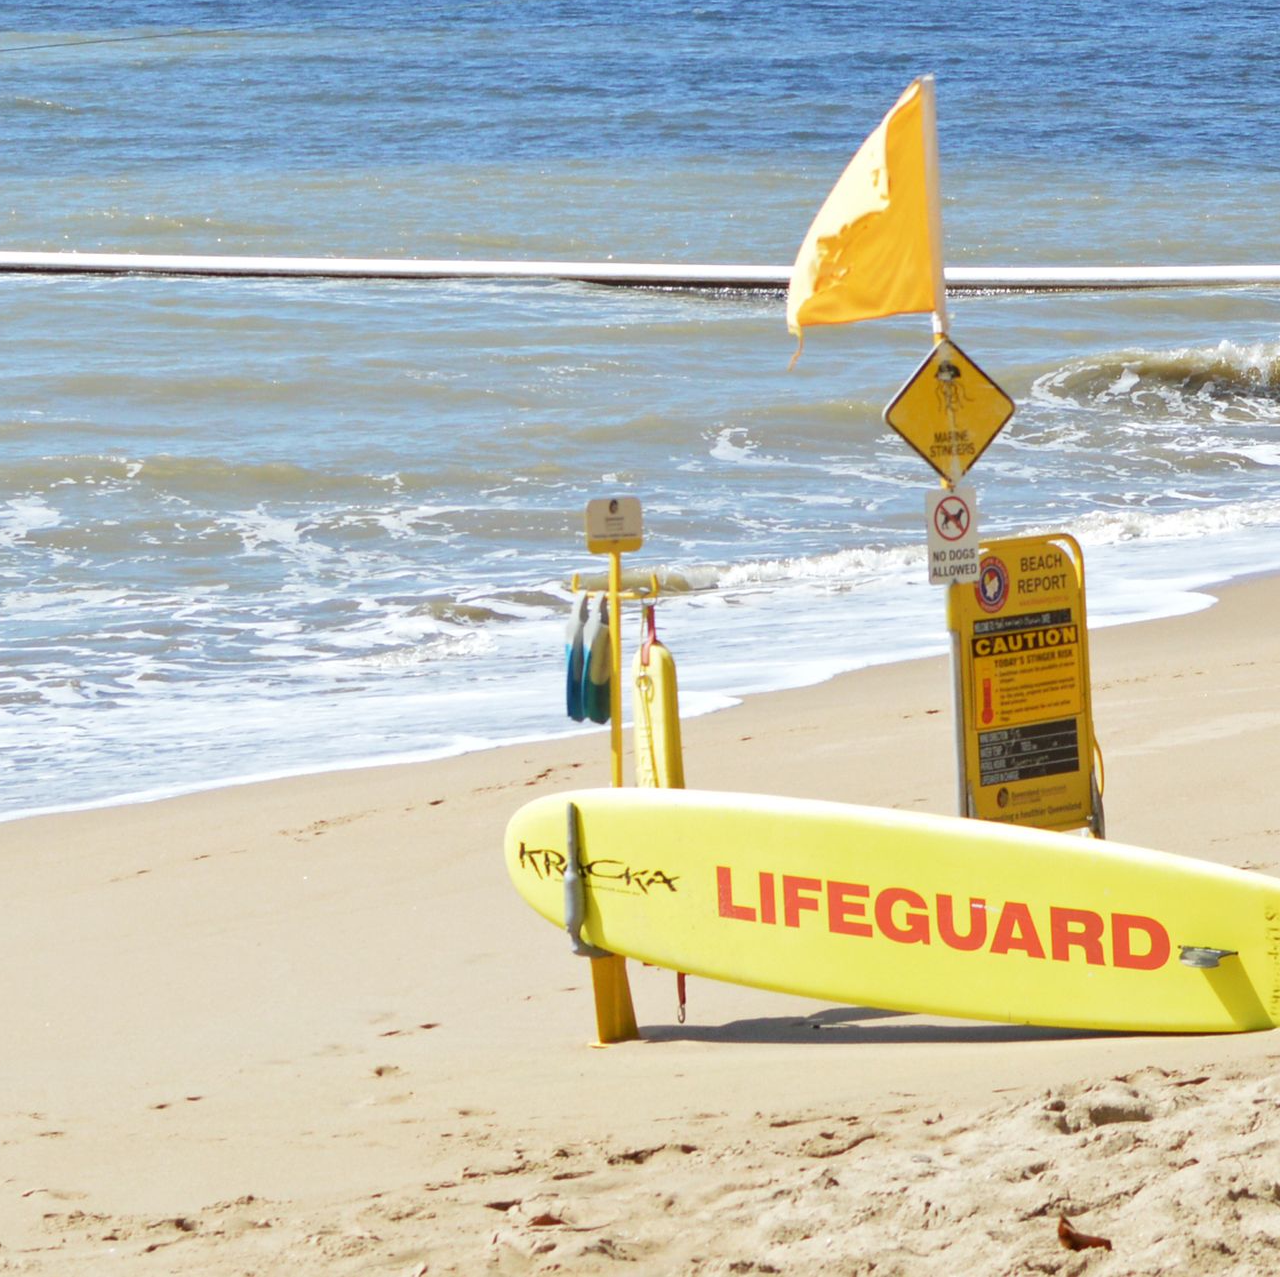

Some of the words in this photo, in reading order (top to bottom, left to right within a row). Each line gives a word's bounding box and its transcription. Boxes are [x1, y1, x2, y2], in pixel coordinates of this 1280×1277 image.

[932, 550, 947, 562] NO
[949, 548, 976, 561] DOGS
[1020, 553, 1063, 572] BEACH
[932, 563, 977, 577] ALLOWED
[1017, 574, 1068, 594] REPORT
[975, 626, 1077, 656] CAUTION
[716, 866, 1171, 972] LIFEGUARD
